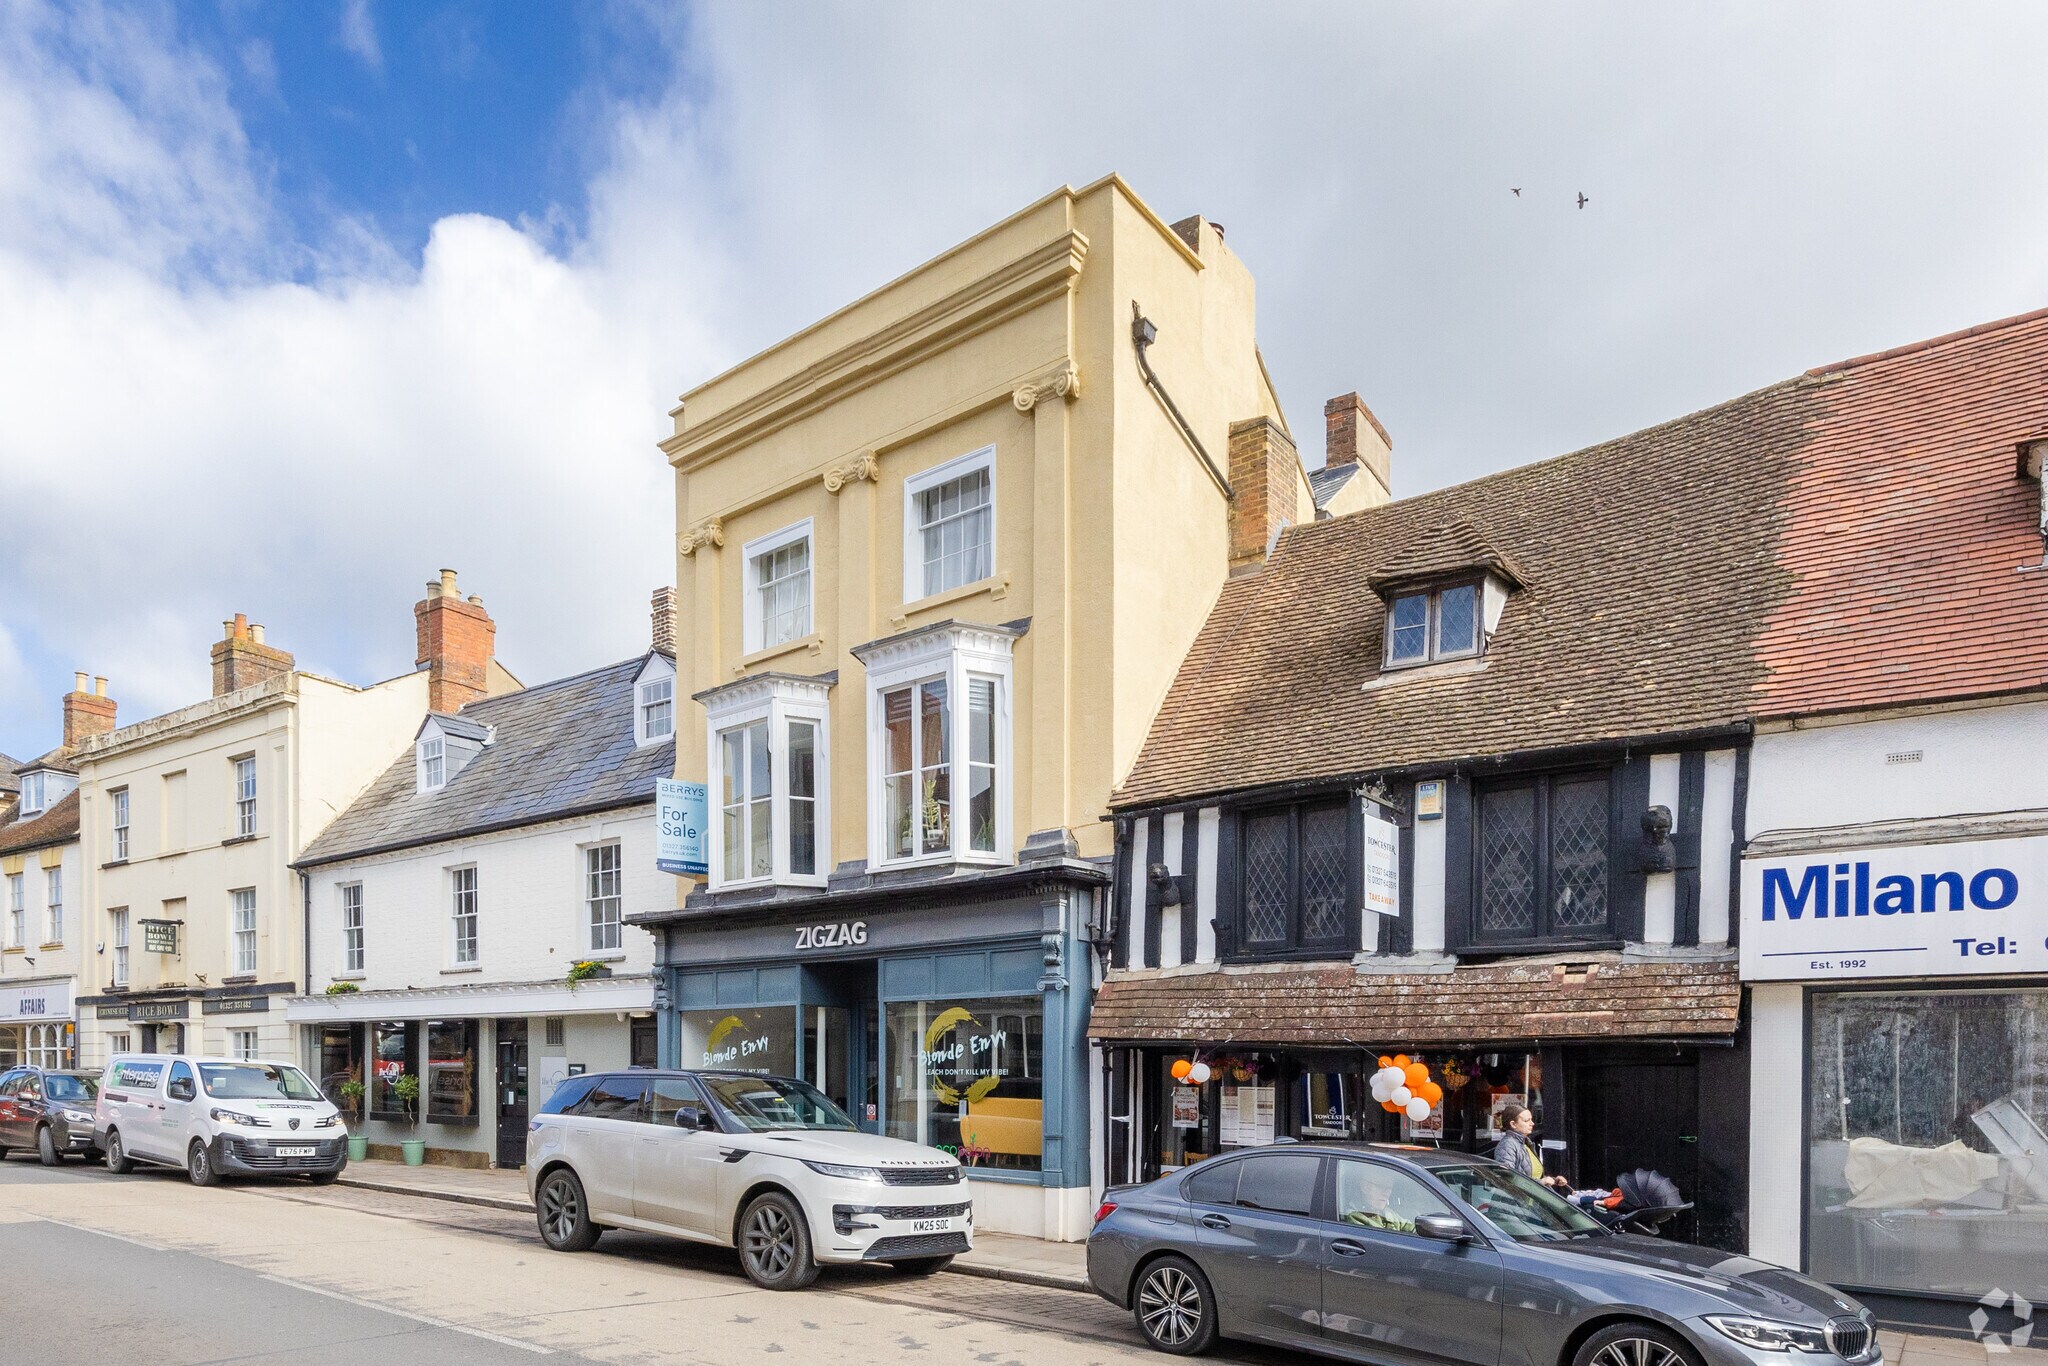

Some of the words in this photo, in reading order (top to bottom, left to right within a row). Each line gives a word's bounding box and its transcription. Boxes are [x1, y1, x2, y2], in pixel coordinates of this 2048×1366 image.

[662, 783, 704, 797] BERRYS
[663, 806, 688, 822] For
[663, 822, 697, 839] Sale
[1367, 836, 1397, 856] TOWCESTER
[1369, 892, 1395, 906] TAKEAWAY
[1762, 861, 2019, 921] Milano
[148, 925, 174, 935] RICE
[148, 932, 174, 941] BOWL
[795, 921, 868, 949] ZIGZAG
[1953, 937, 2017, 956] Tel:
[1810, 961, 1833, 969] Est.
[1839, 960, 1866, 969] 1992
[20, 998, 45, 1015] AFFAIRS
[136, 1005, 155, 1017] RICE
[157, 1004, 180, 1016] BOWL
[703, 1047, 737, 1067] Blonde
[918, 1043, 964, 1067] Blonde
[115, 1067, 160, 1085] enterprise
[944, 1068, 964, 1076] DON'T
[965, 1068, 979, 1076] KILL
[980, 1068, 990, 1076] MY
[991, 1068, 1009, 1076] VIBE!
[913, 1220, 934, 1232] KM25
